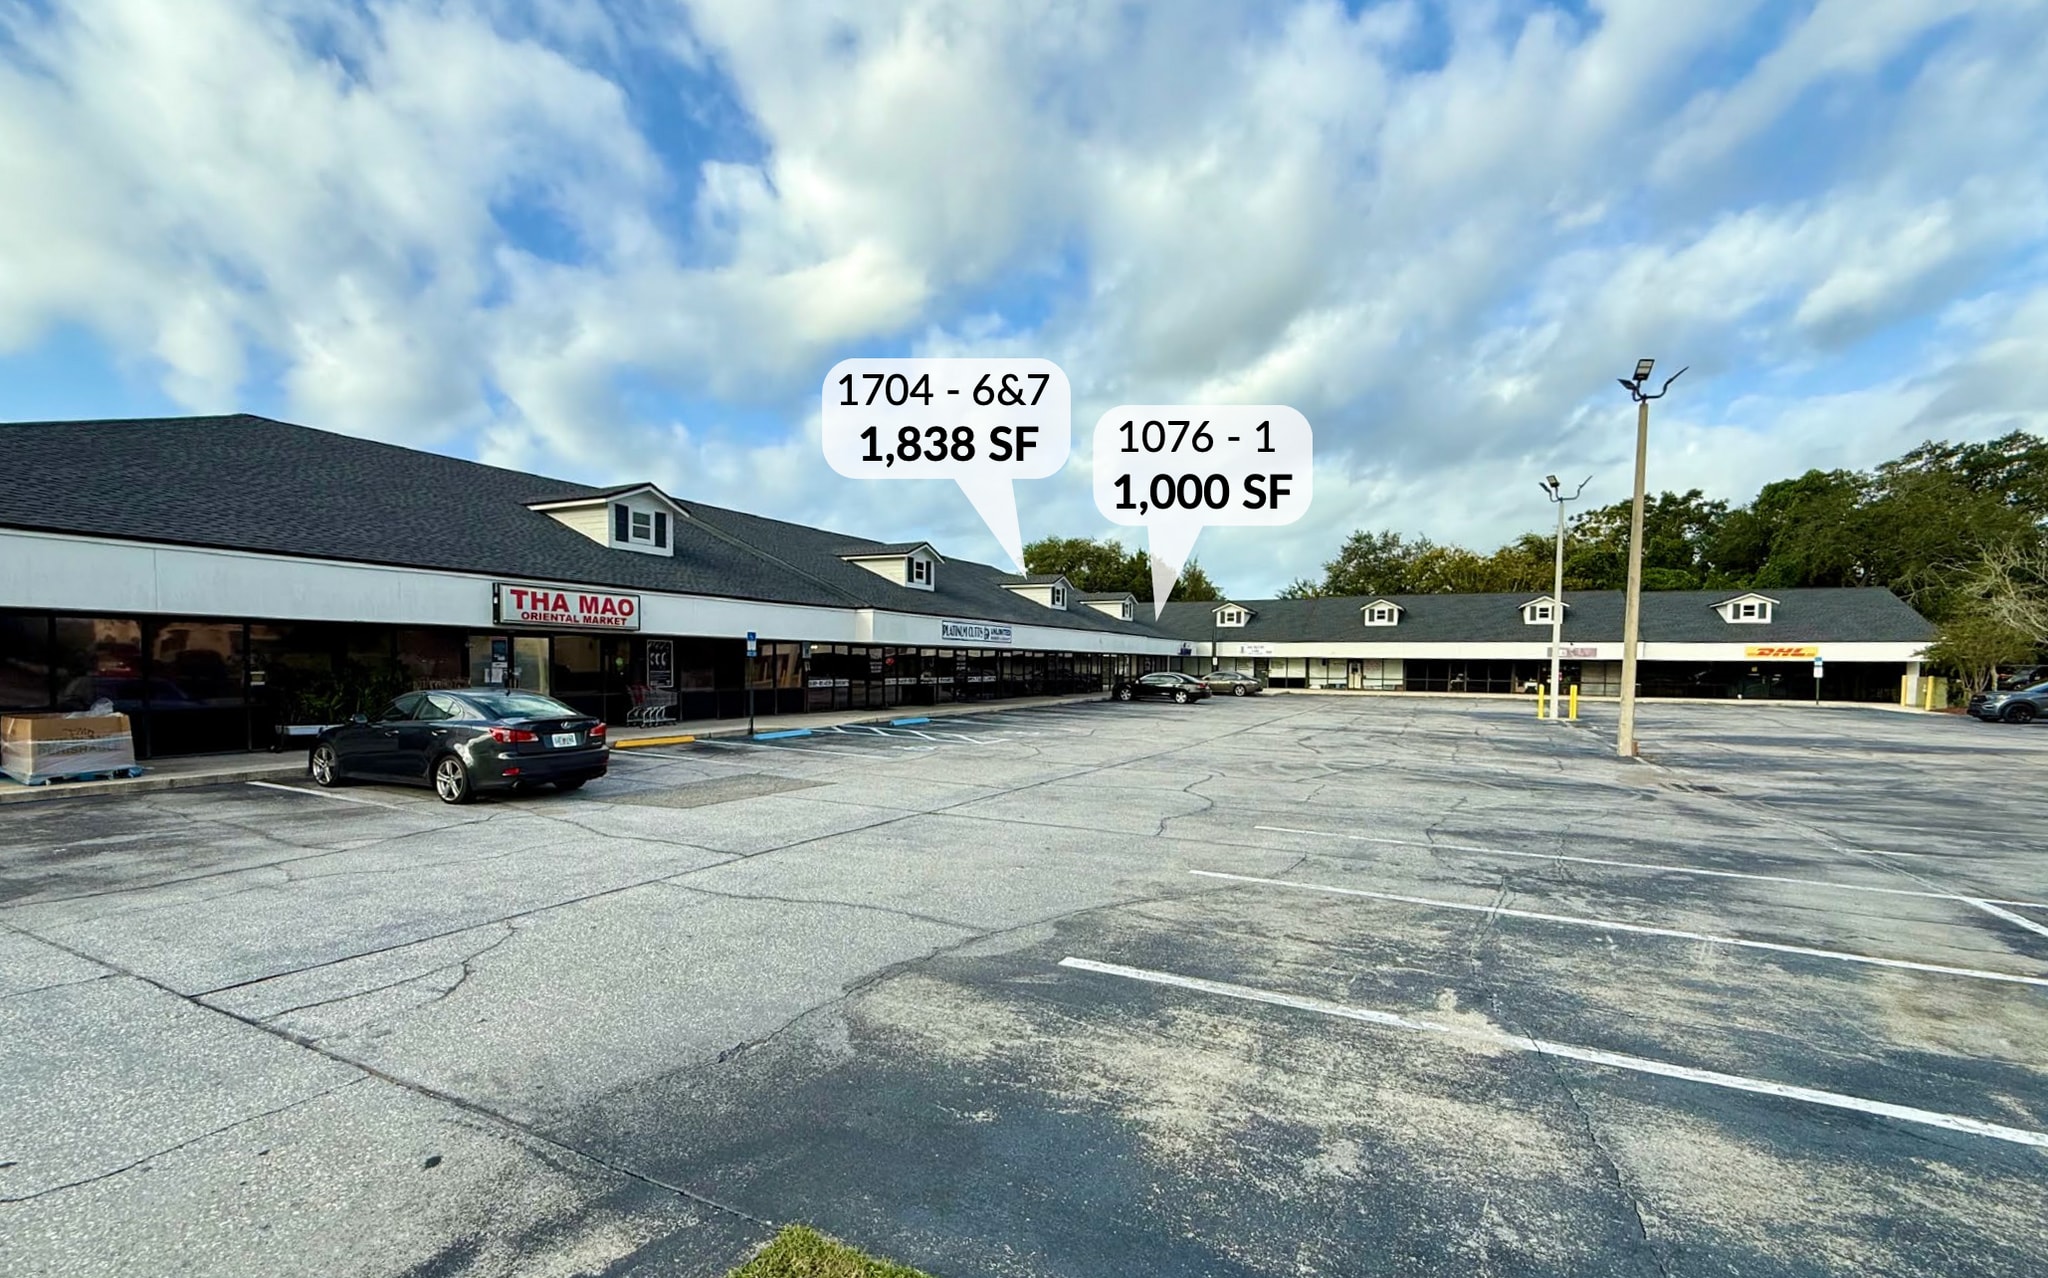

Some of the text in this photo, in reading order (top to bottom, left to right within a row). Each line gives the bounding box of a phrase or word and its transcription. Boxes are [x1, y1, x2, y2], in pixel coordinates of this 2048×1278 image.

[510, 588, 635, 617] THA MAO
[521, 611, 627, 626] ORIENTAL MARKET
[942, 624, 968, 637] PLATINUM
[1758, 647, 1805, 657] DHL
